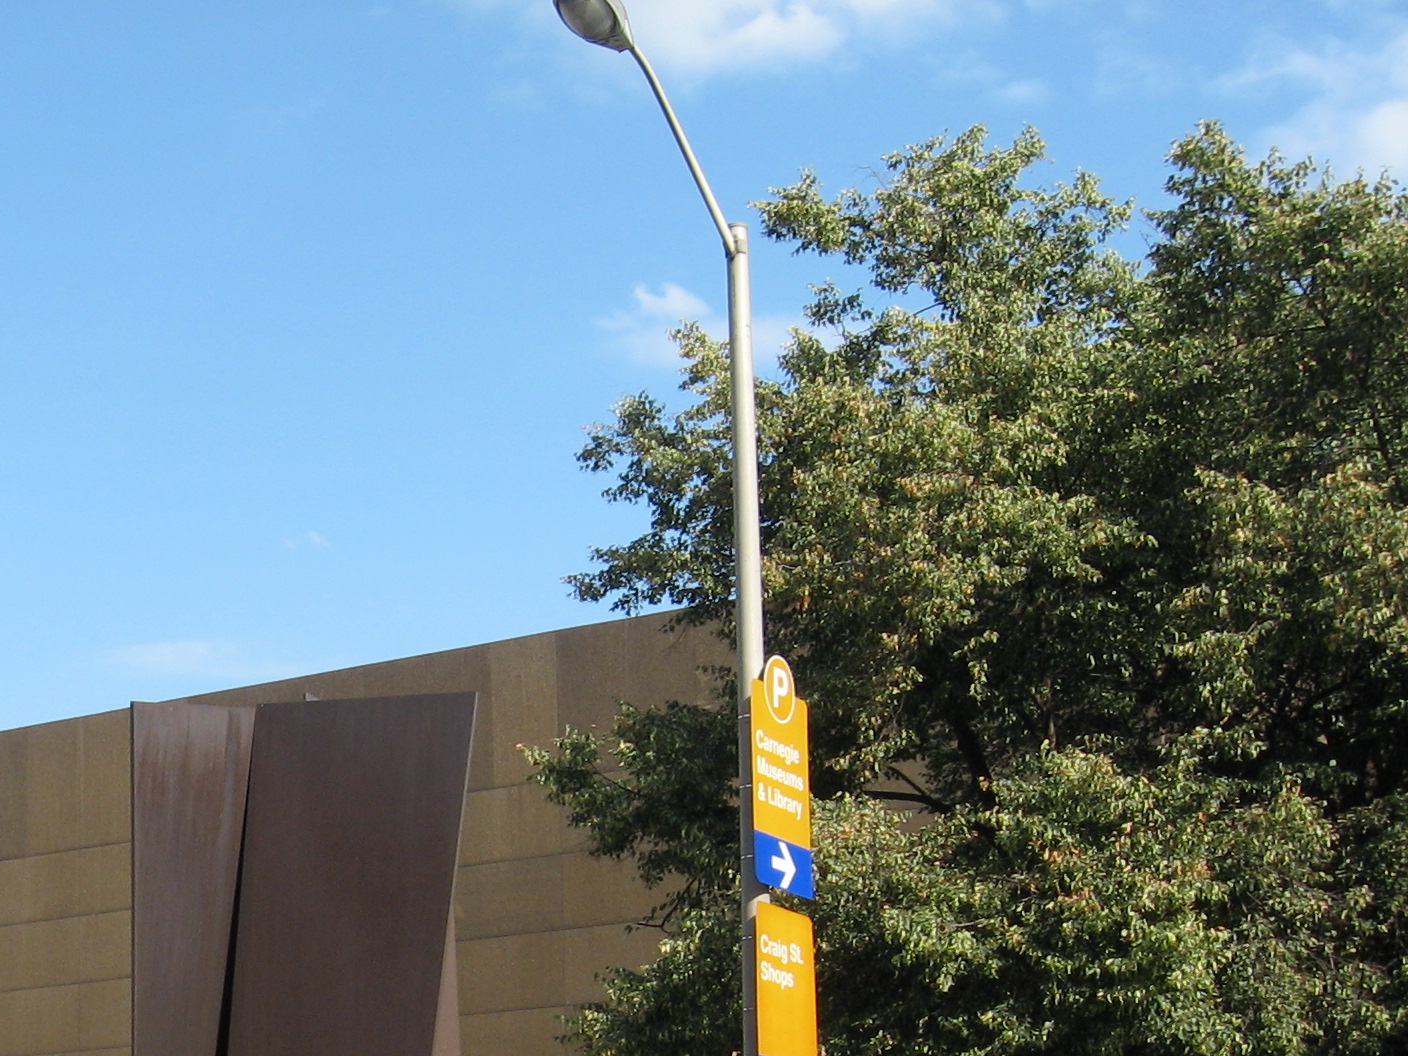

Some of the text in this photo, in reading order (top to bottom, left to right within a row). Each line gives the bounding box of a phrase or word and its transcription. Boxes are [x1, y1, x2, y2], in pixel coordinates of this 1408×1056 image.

[772, 666, 789, 708] P
[756, 729, 800, 765] Carnegie
[757, 755, 804, 791] Museums
[758, 782, 802, 820] & Library
[760, 934, 804, 965] Craig St.
[760, 960, 794, 990] Shops
